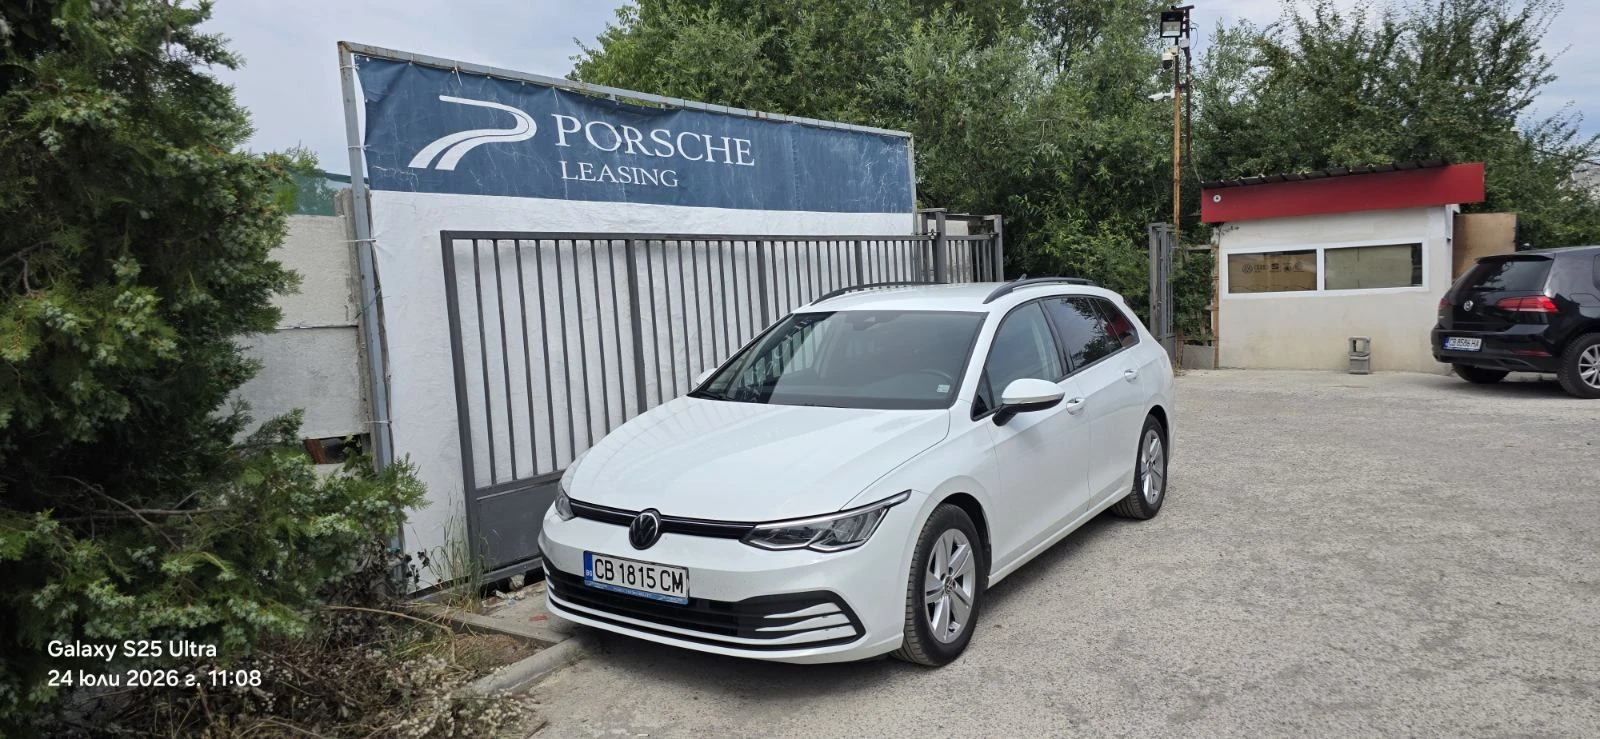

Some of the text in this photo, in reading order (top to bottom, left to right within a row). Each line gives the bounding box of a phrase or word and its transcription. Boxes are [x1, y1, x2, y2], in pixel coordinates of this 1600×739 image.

[551, 113, 755, 167] PORSCHE
[558, 160, 680, 187] LEASING
[594, 558, 684, 594] CB 1815 CM
